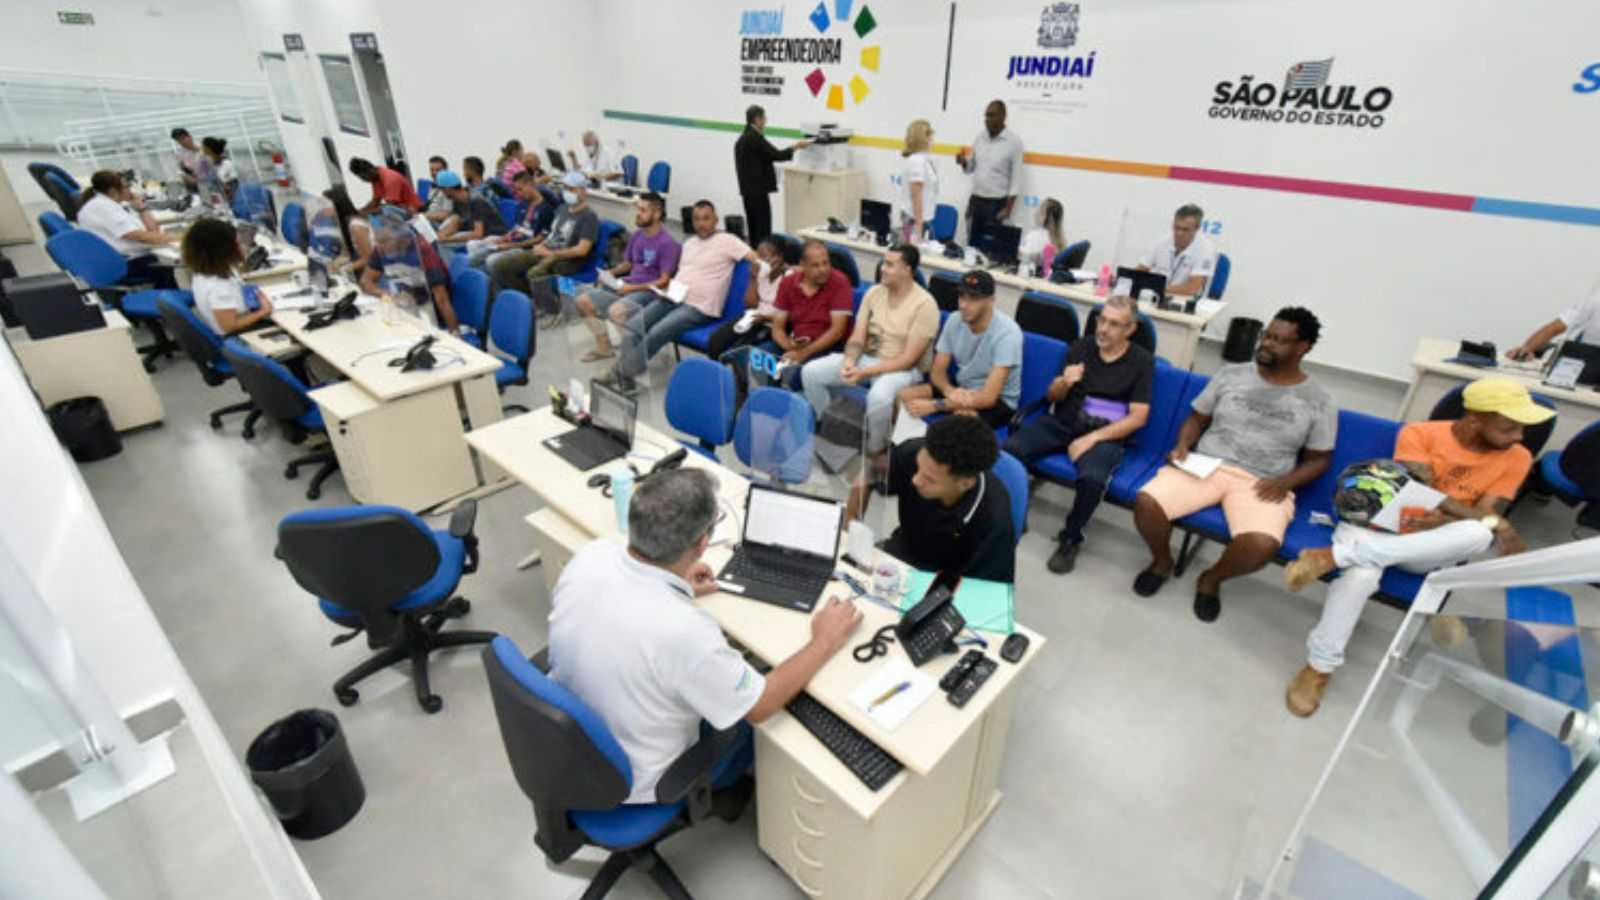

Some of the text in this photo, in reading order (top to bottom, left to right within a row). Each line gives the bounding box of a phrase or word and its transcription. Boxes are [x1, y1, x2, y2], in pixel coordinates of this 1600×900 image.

[741, 37, 842, 64] EMPREENDEDORA
[1006, 50, 1096, 80] JUNDIAÍ
[1212, 75, 1393, 112] SÃO PAULO
[1208, 106, 1385, 128] GOVERNO DO ESTADO
